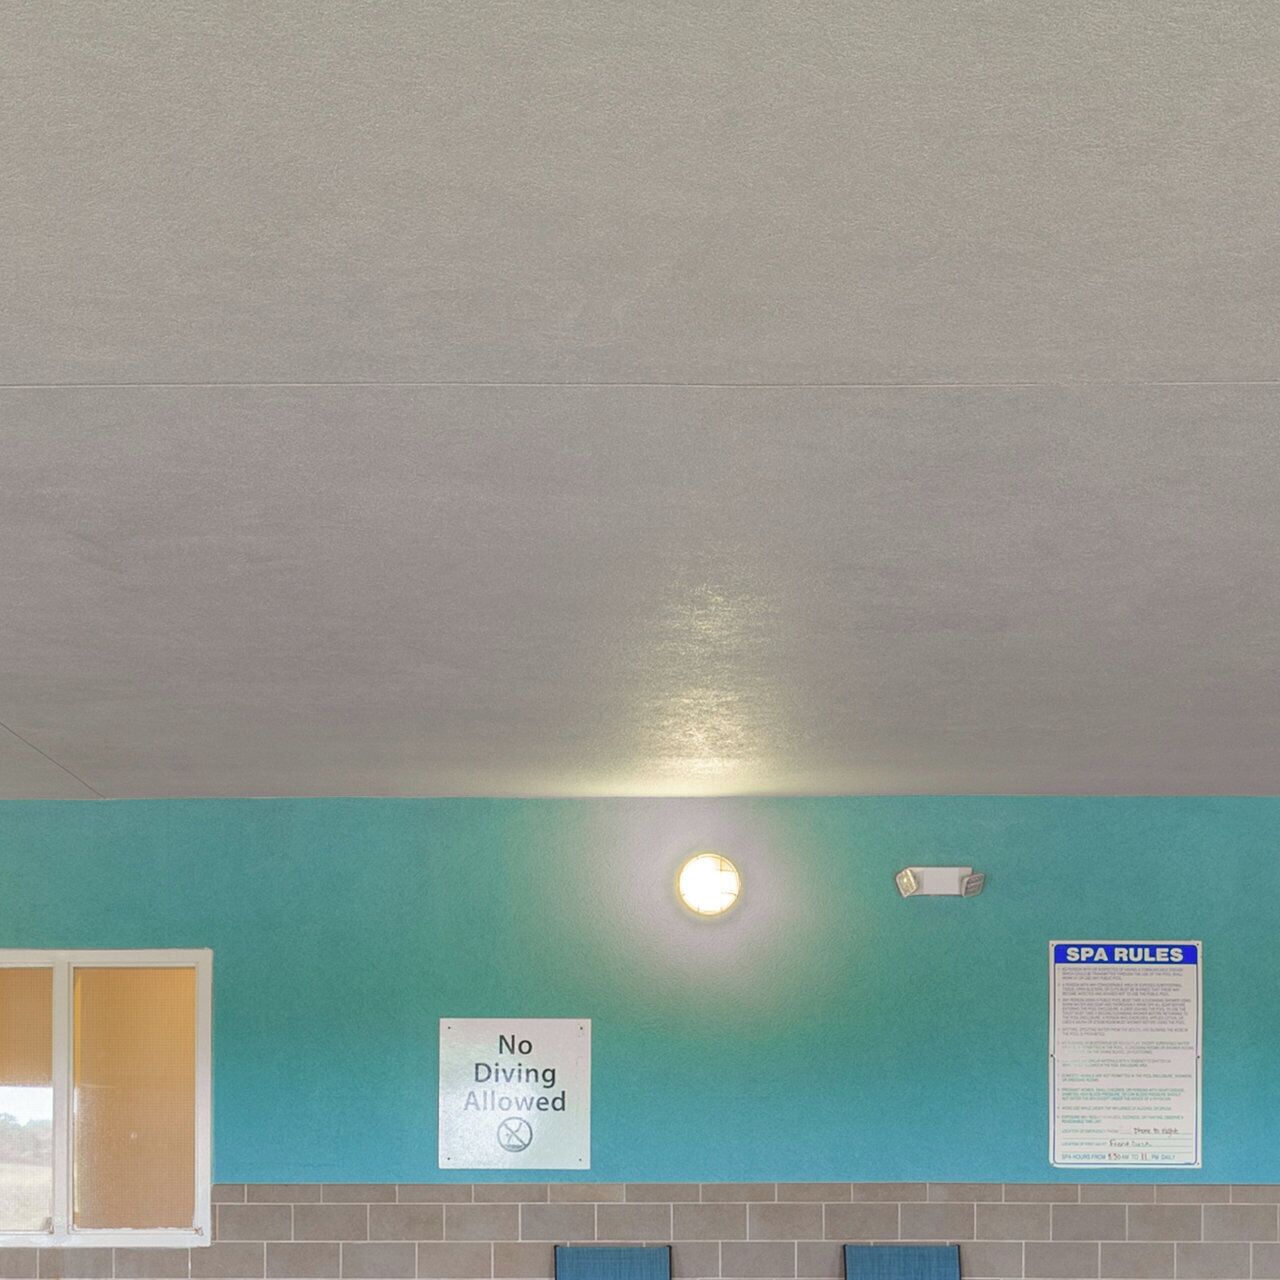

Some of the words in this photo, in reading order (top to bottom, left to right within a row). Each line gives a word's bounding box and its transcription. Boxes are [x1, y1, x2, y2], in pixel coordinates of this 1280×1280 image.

[1066, 947, 1109, 963] SPA
[1114, 947, 1184, 963] RULES
[498, 1034, 533, 1055] No
[475, 1062, 556, 1088] Diving
[463, 1091, 566, 1112] Allowed
